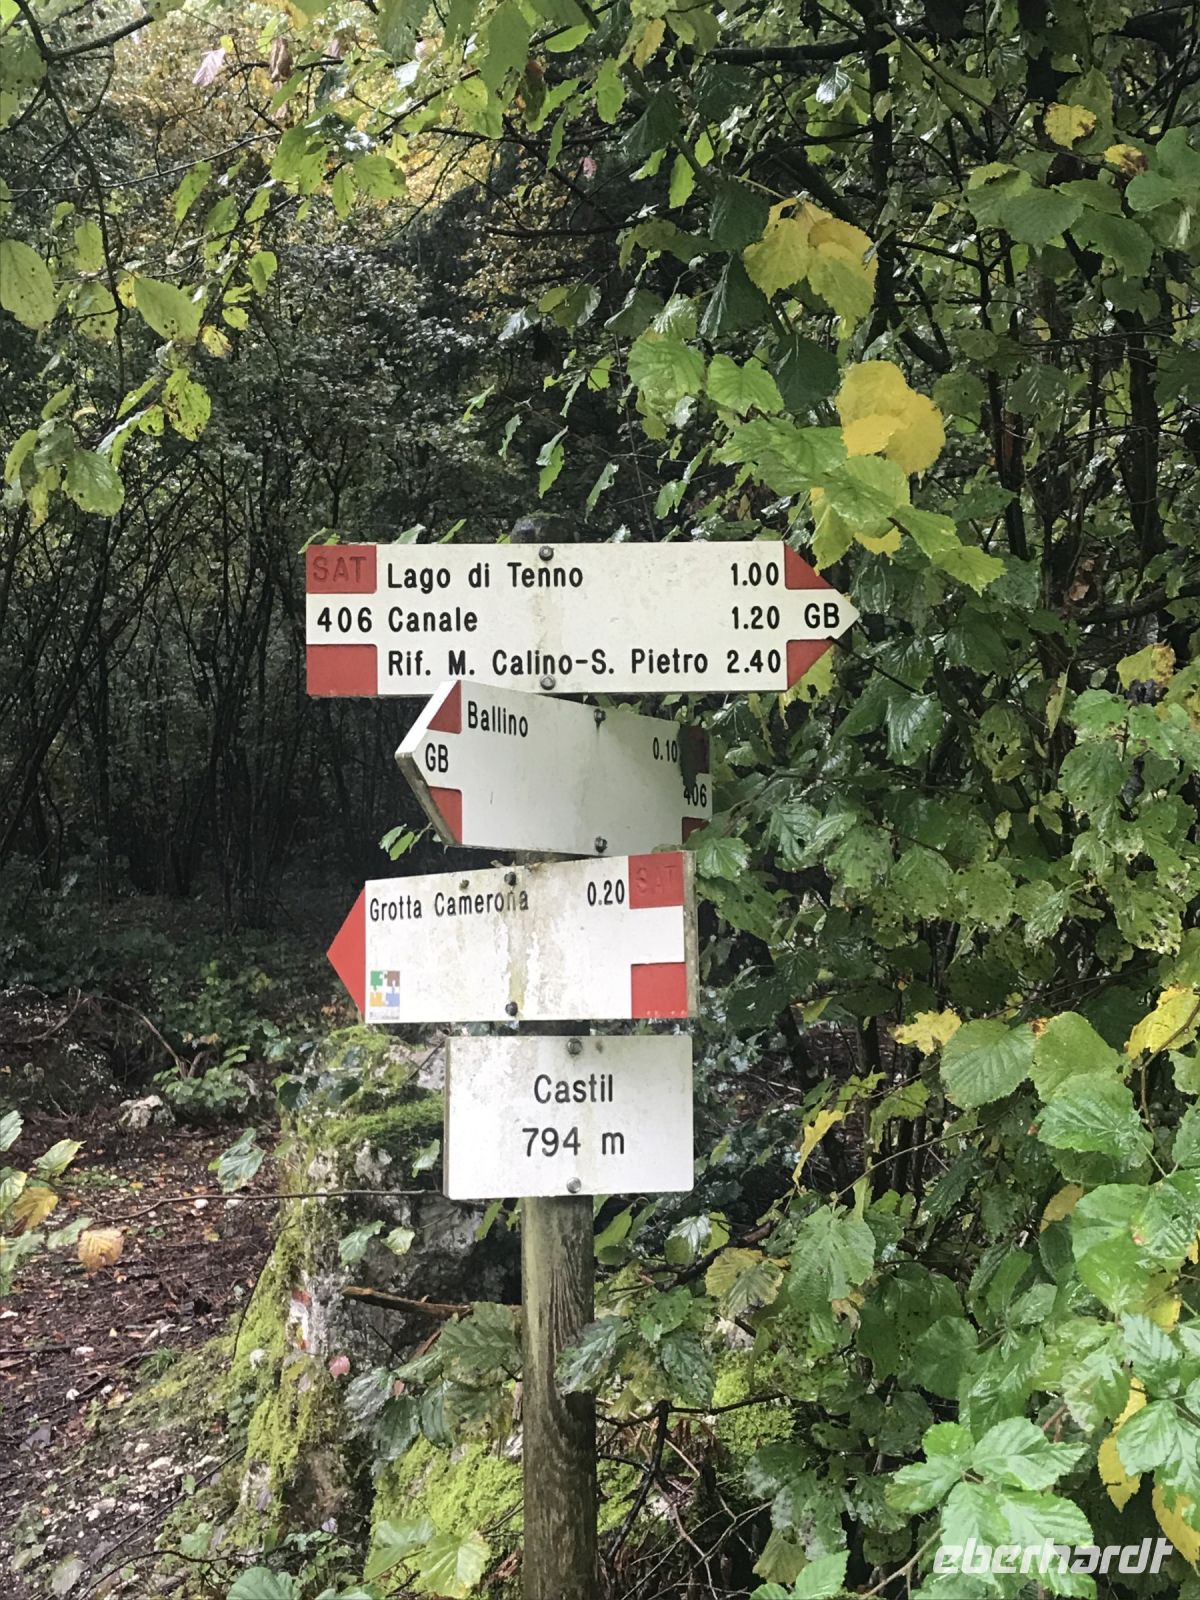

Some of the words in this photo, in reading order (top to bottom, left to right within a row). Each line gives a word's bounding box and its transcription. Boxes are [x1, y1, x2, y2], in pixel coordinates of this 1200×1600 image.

[313, 555, 367, 583] SAT
[388, 563, 451, 594] Lago
[468, 562, 490, 587] di
[507, 562, 584, 588] Tenno
[731, 562, 780, 586] 1.00
[317, 607, 372, 632] 406
[388, 607, 478, 632] Canale
[731, 607, 780, 630] 1.20
[804, 603, 840, 629] GB
[389, 651, 431, 676] Rif.
[449, 650, 475, 675] M.
[493, 649, 615, 675] Calino-S.
[632, 649, 708, 674] Pietro
[727, 649, 782, 673] 2.40
[467, 700, 529, 738] Ballino
[653, 737, 677, 762] 0.10
[425, 742, 449, 773] GB
[684, 783, 707, 807] 406
[370, 895, 422, 921] Grotta
[434, 890, 529, 919] Camerona
[587, 879, 625, 906] 0.20
[534, 1073, 613, 1104] Castil
[522, 1127, 581, 1157] 794
[601, 1131, 625, 1155] m
